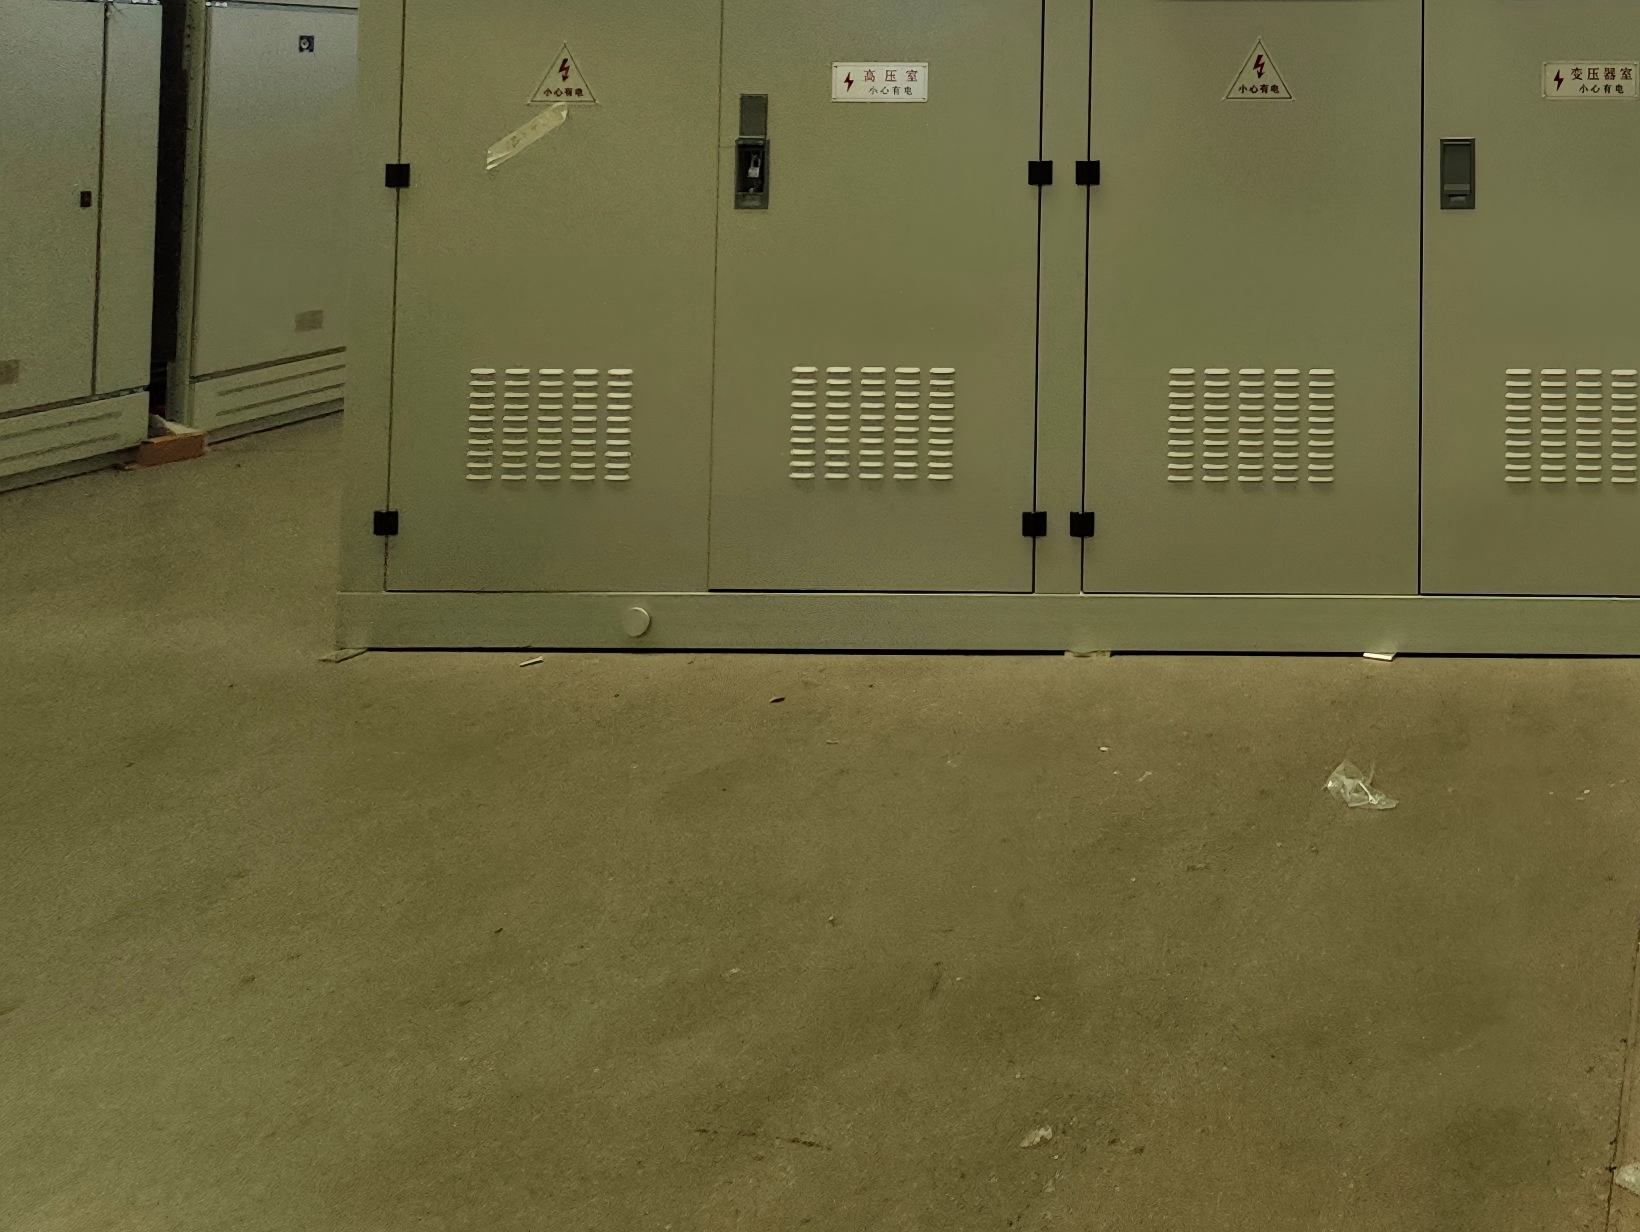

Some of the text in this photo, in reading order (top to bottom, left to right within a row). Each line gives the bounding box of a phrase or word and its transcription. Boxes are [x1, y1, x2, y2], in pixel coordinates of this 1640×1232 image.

[863, 68, 919, 83] 高压室
[1570, 67, 1633, 81] 变压器室
[543, 87, 584, 97] 小心有电
[868, 85, 913, 96] 小心有电
[1238, 83, 1280, 94] 小心有电
[1578, 83, 1624, 94] 小心有电
